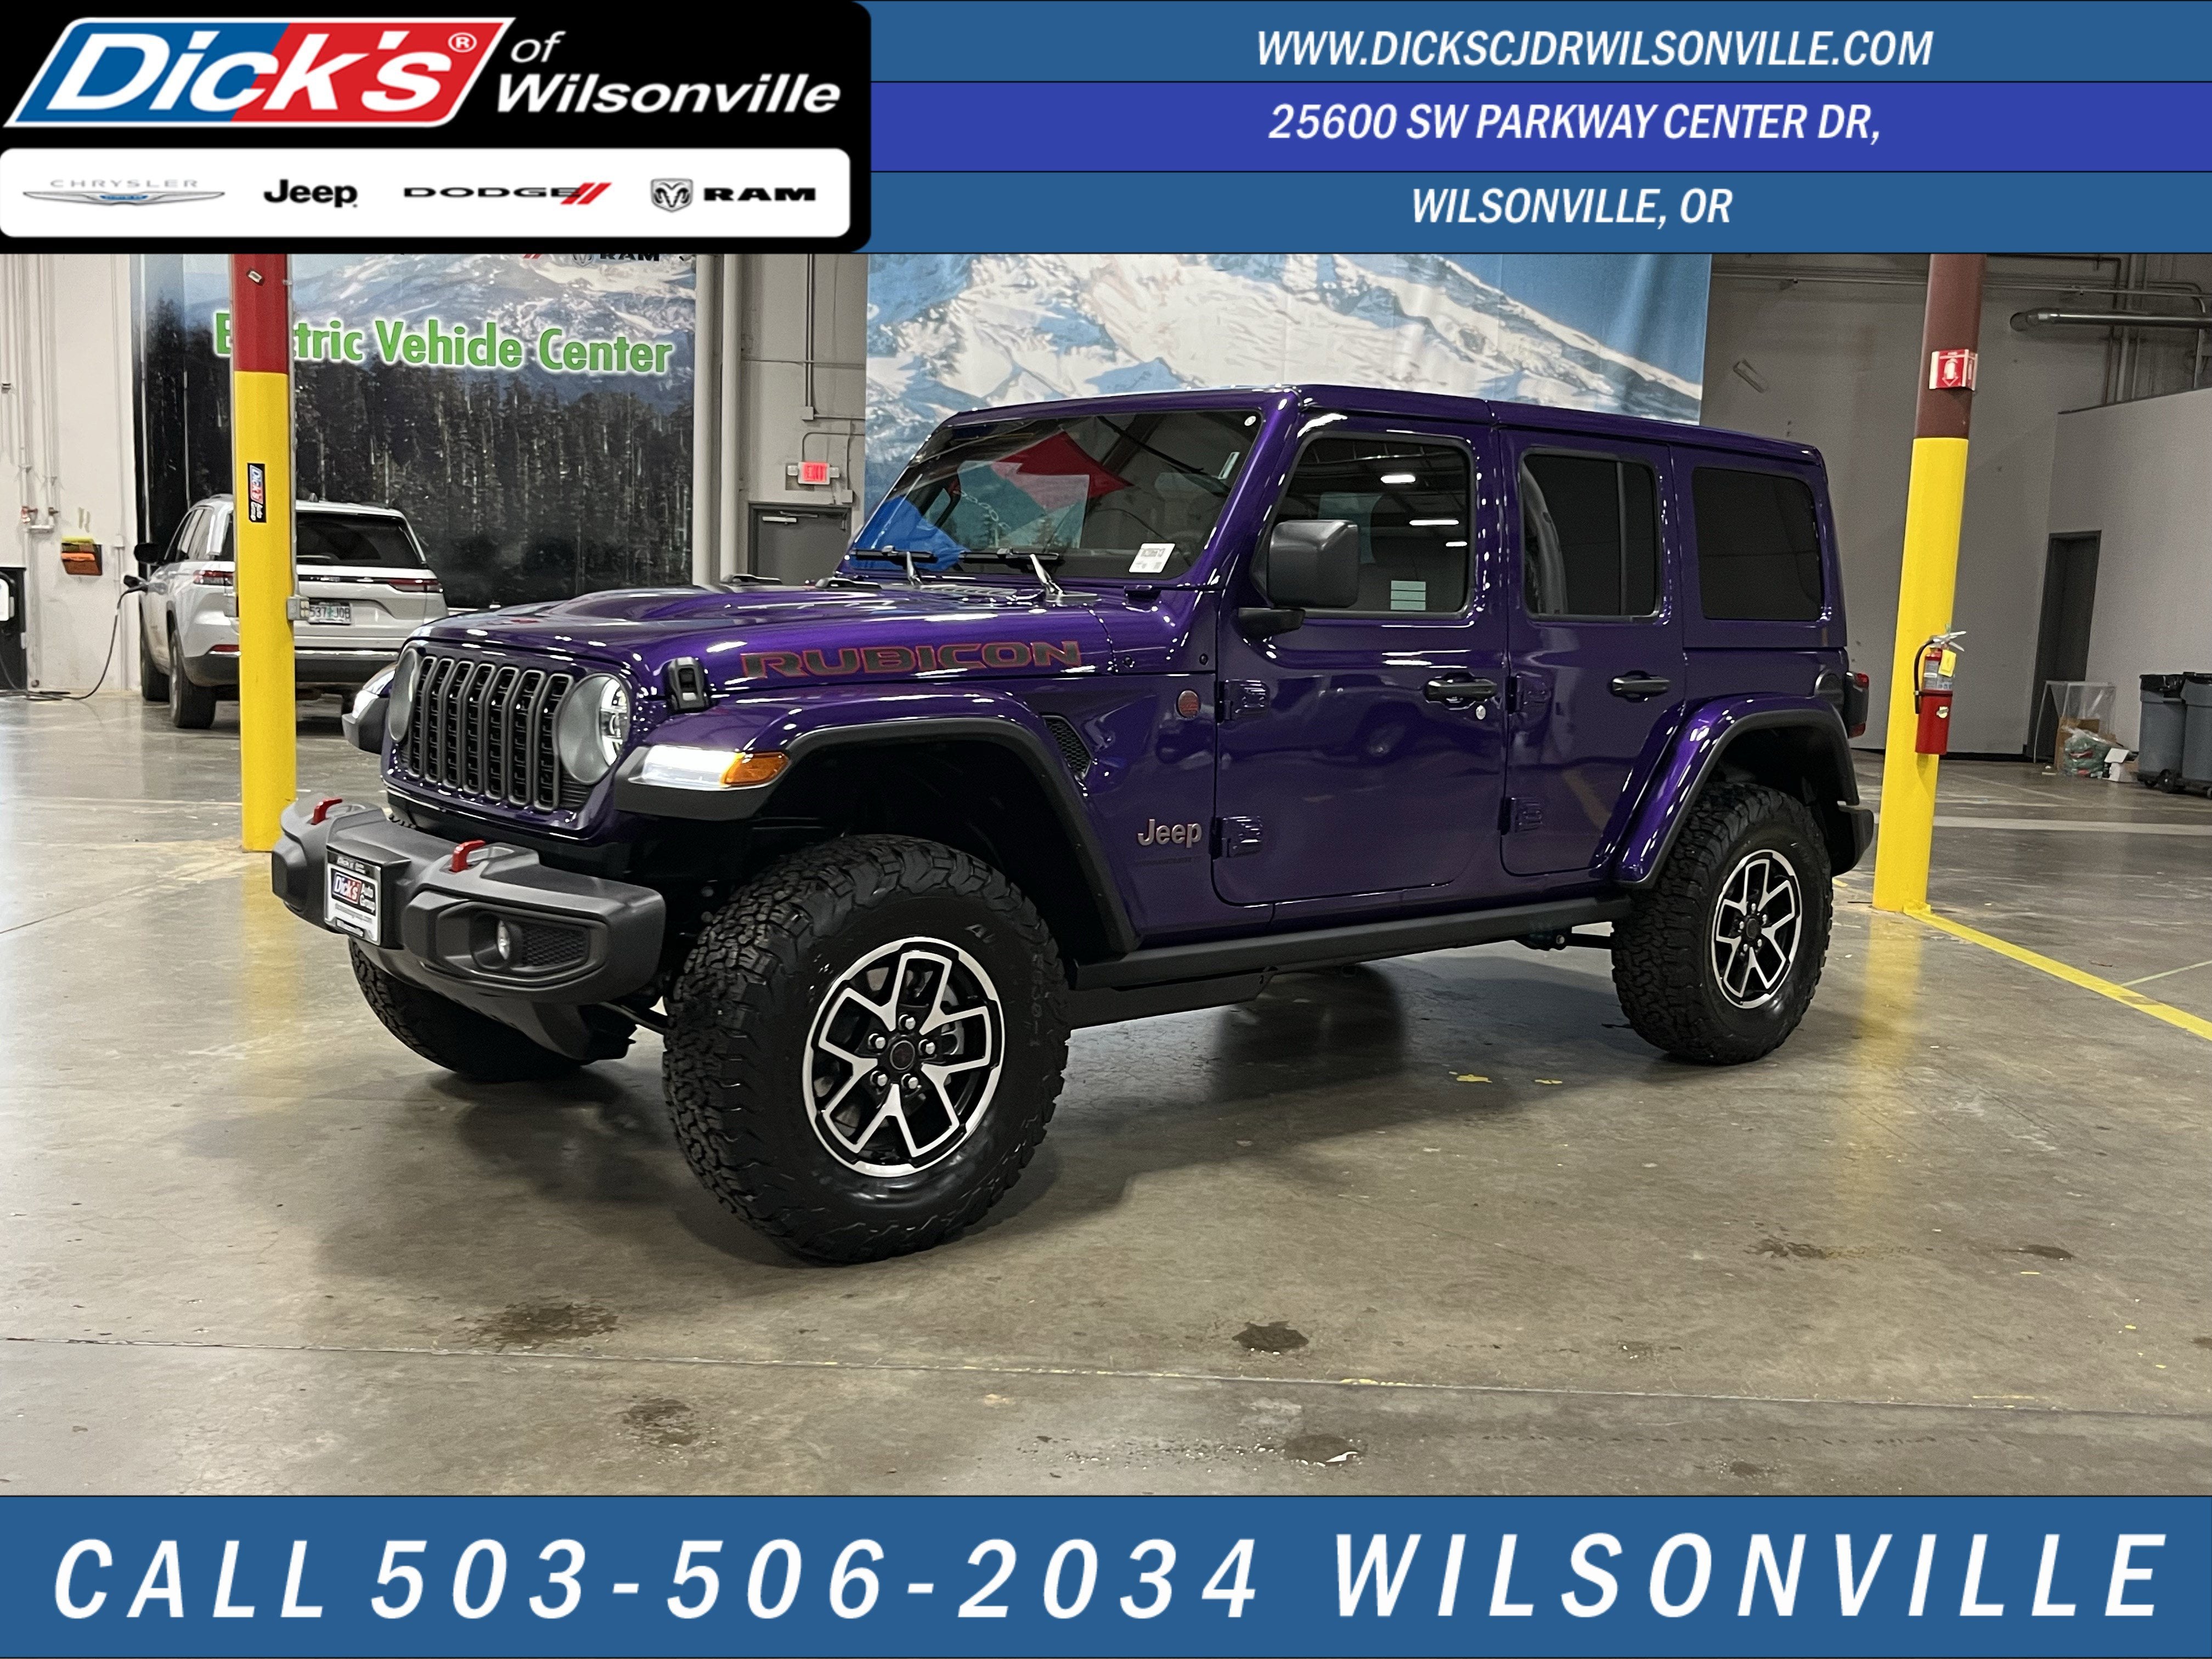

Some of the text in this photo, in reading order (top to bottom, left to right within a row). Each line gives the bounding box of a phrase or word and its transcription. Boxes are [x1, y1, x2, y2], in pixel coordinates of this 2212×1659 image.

[375, 319, 521, 367] Vehicle
[539, 328, 673, 371] Center
[740, 641, 1082, 678] RUBICON
[1137, 819, 1203, 848] Jeep
